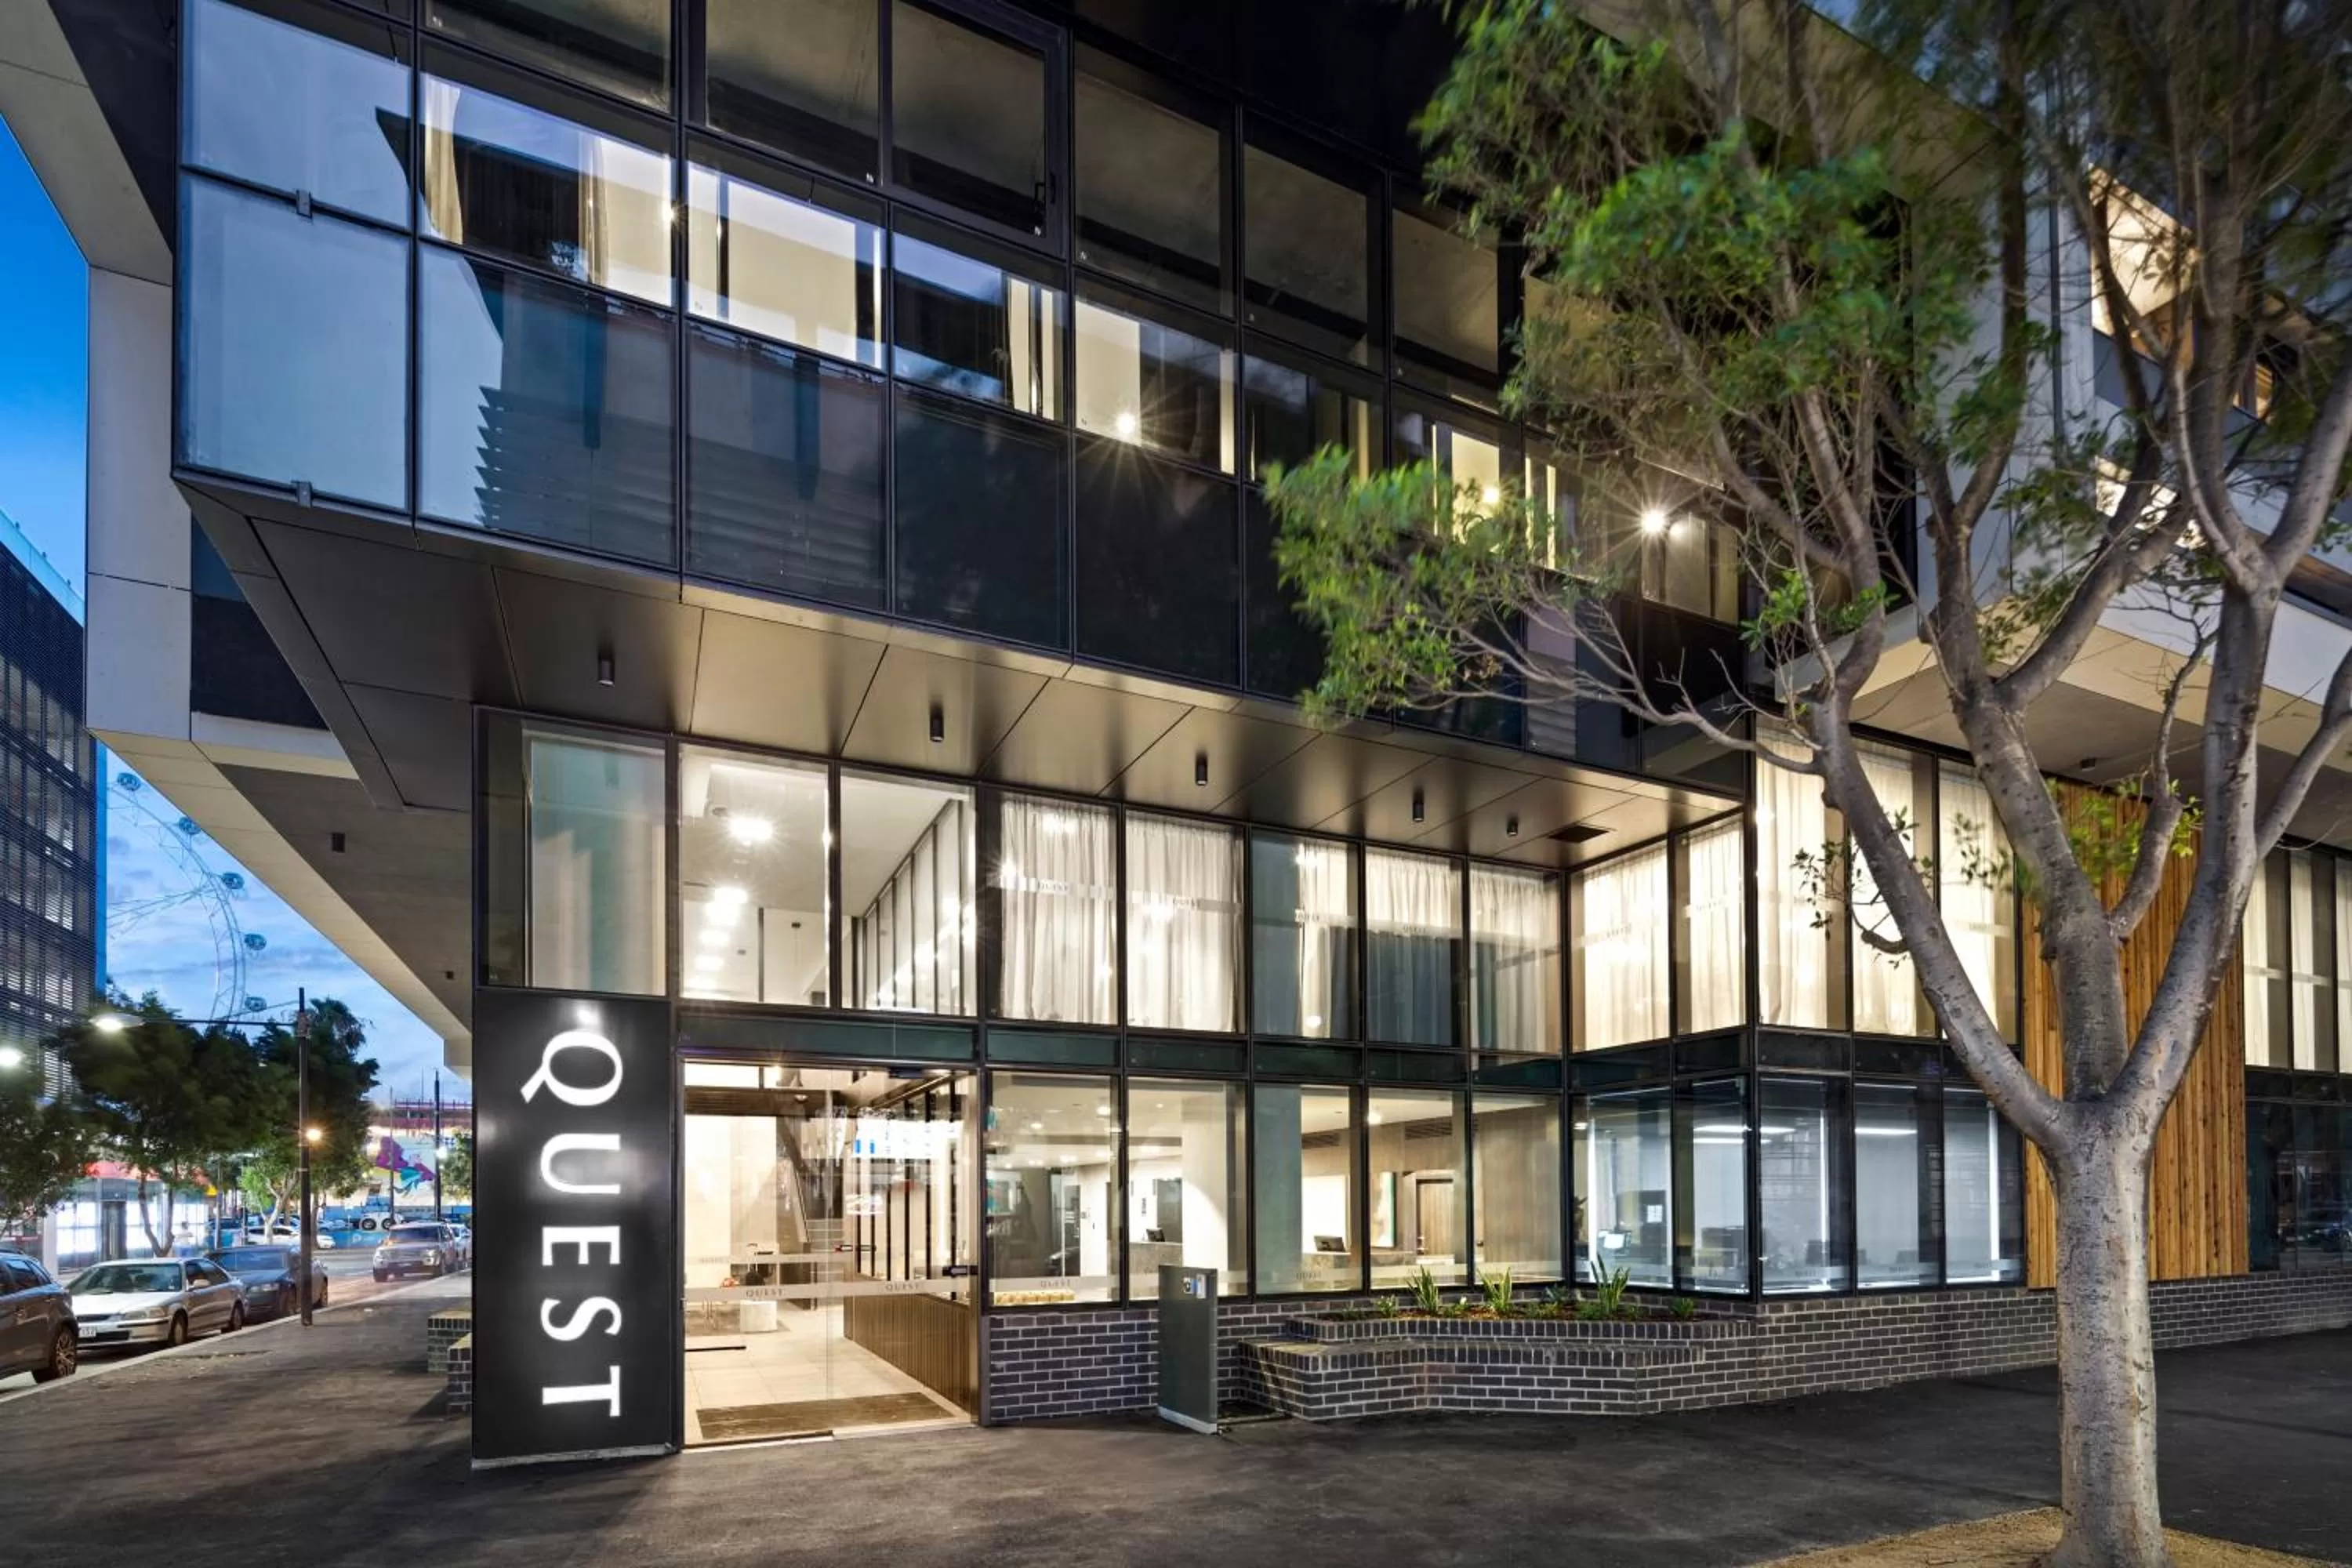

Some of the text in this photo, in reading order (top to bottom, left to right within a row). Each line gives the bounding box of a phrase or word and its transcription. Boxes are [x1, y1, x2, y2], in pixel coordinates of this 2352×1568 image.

[520, 1029, 623, 1417] QUEST
[746, 1288, 782, 1298] QUEST
[884, 1282, 920, 1293] QUEST
